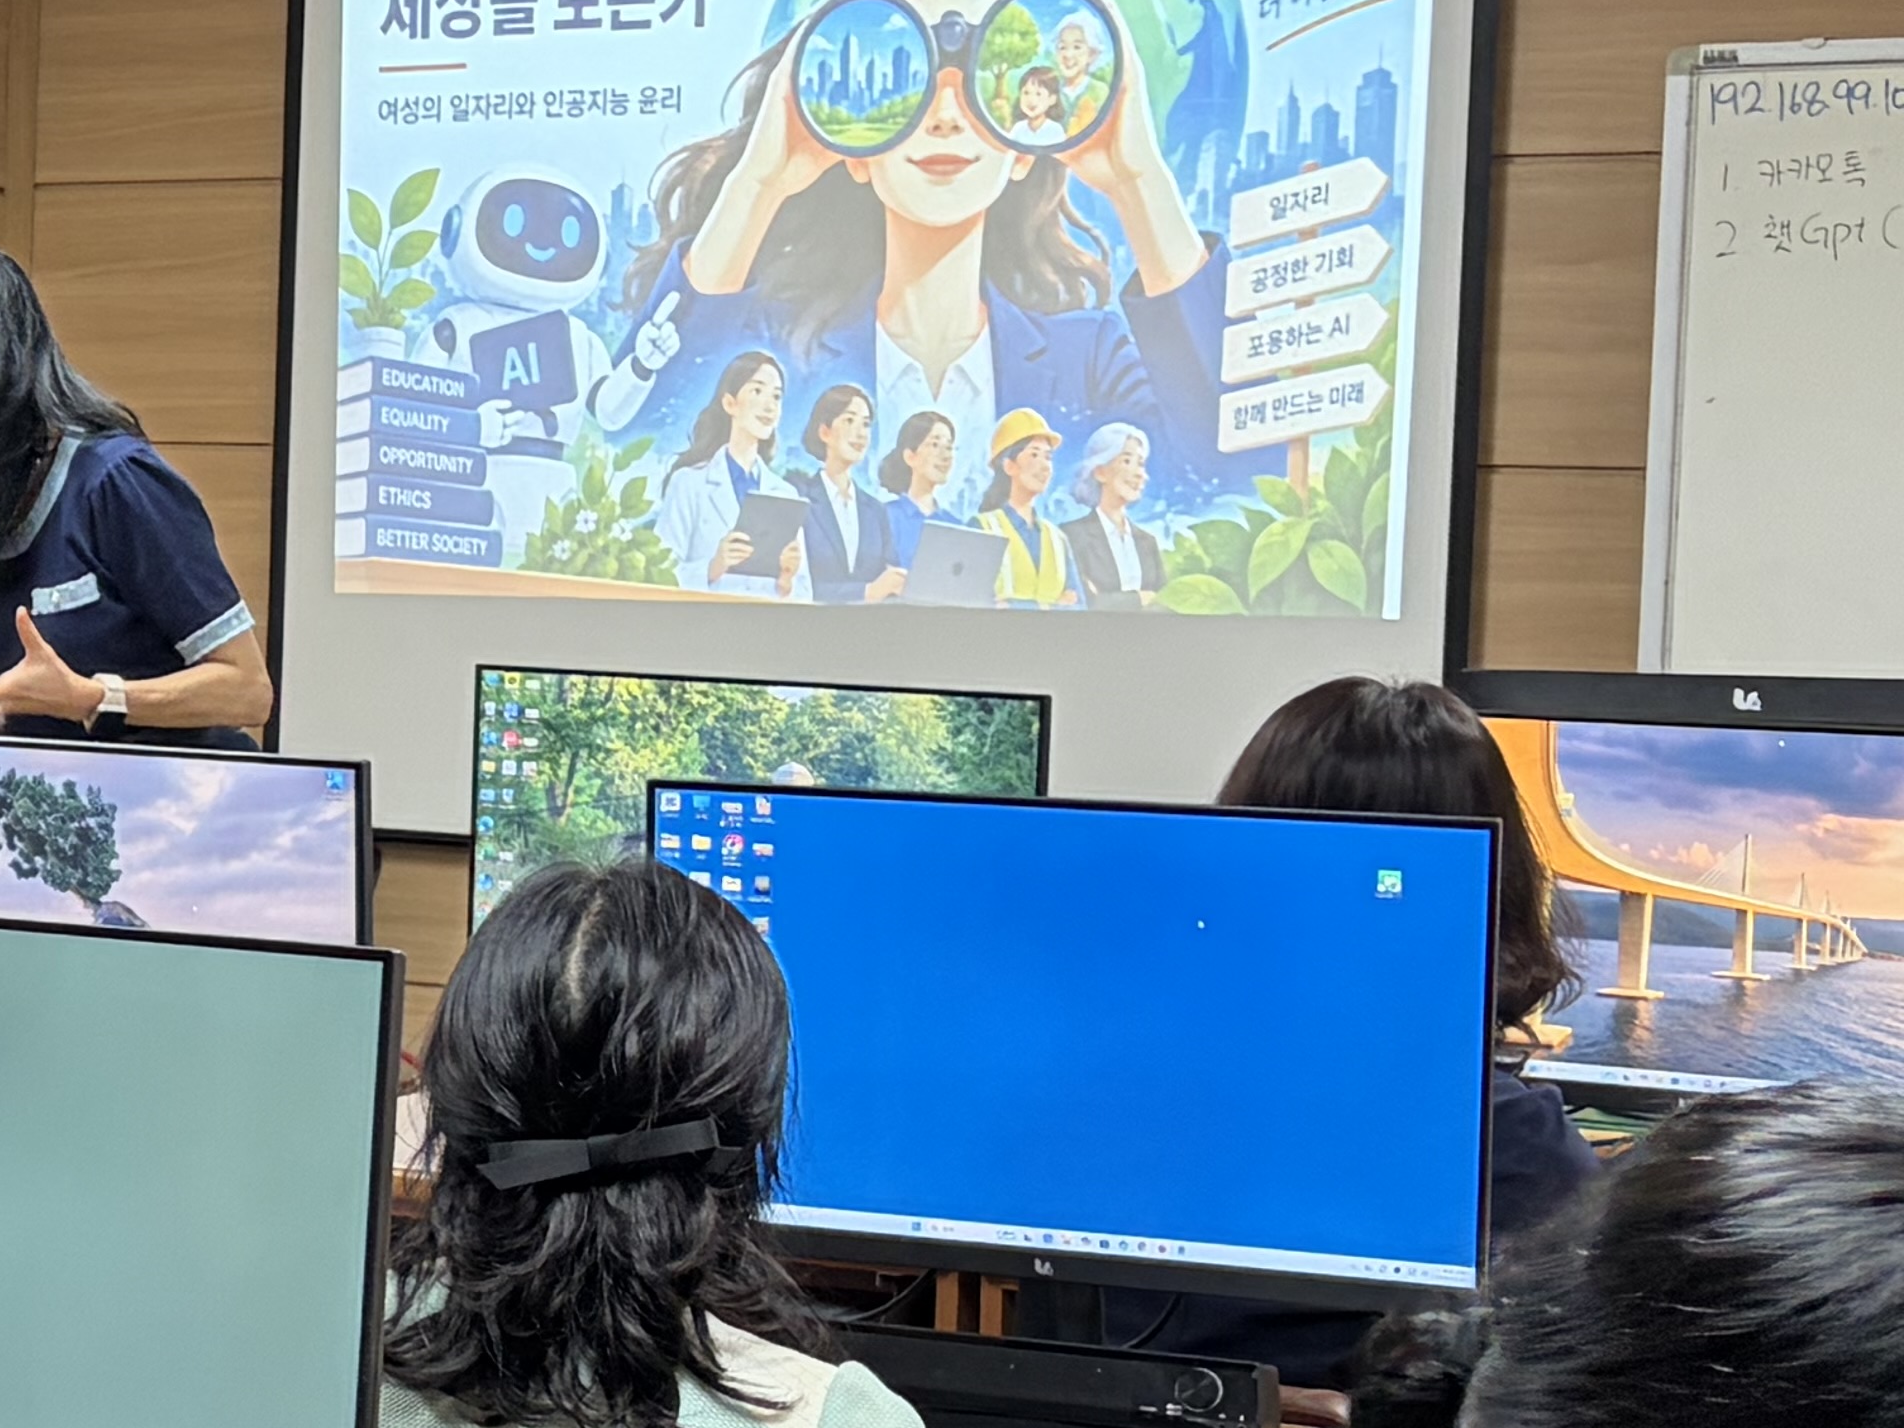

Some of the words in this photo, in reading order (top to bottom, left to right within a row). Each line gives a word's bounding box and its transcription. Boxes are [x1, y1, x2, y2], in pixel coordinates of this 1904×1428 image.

[378, 94, 442, 127] 여성의
[449, 90, 536, 124] 일자리와
[544, 88, 629, 119] 인공지능
[638, 85, 683, 115] 윤리
[1757, 150, 1867, 188] 카카오톡
[1269, 182, 1330, 220] 일자리
[1251, 258, 1309, 294] 공정한
[1315, 244, 1354, 274] 기회
[1247, 322, 1324, 359] 포용하는
[1328, 314, 1350, 338] AI
[382, 368, 465, 398] EDUCATION
[501, 342, 540, 391] AI
[380, 406, 450, 433] EQUALITY
[1233, 400, 1267, 430] 함께
[1271, 391, 1324, 421] 만드는
[1329, 381, 1364, 407] 미래
[379, 447, 473, 475] OPPORTUNITY
[378, 486, 432, 510] ETHICS
[376, 529, 431, 554] BETTER
[432, 533, 488, 557] SOCIETY
